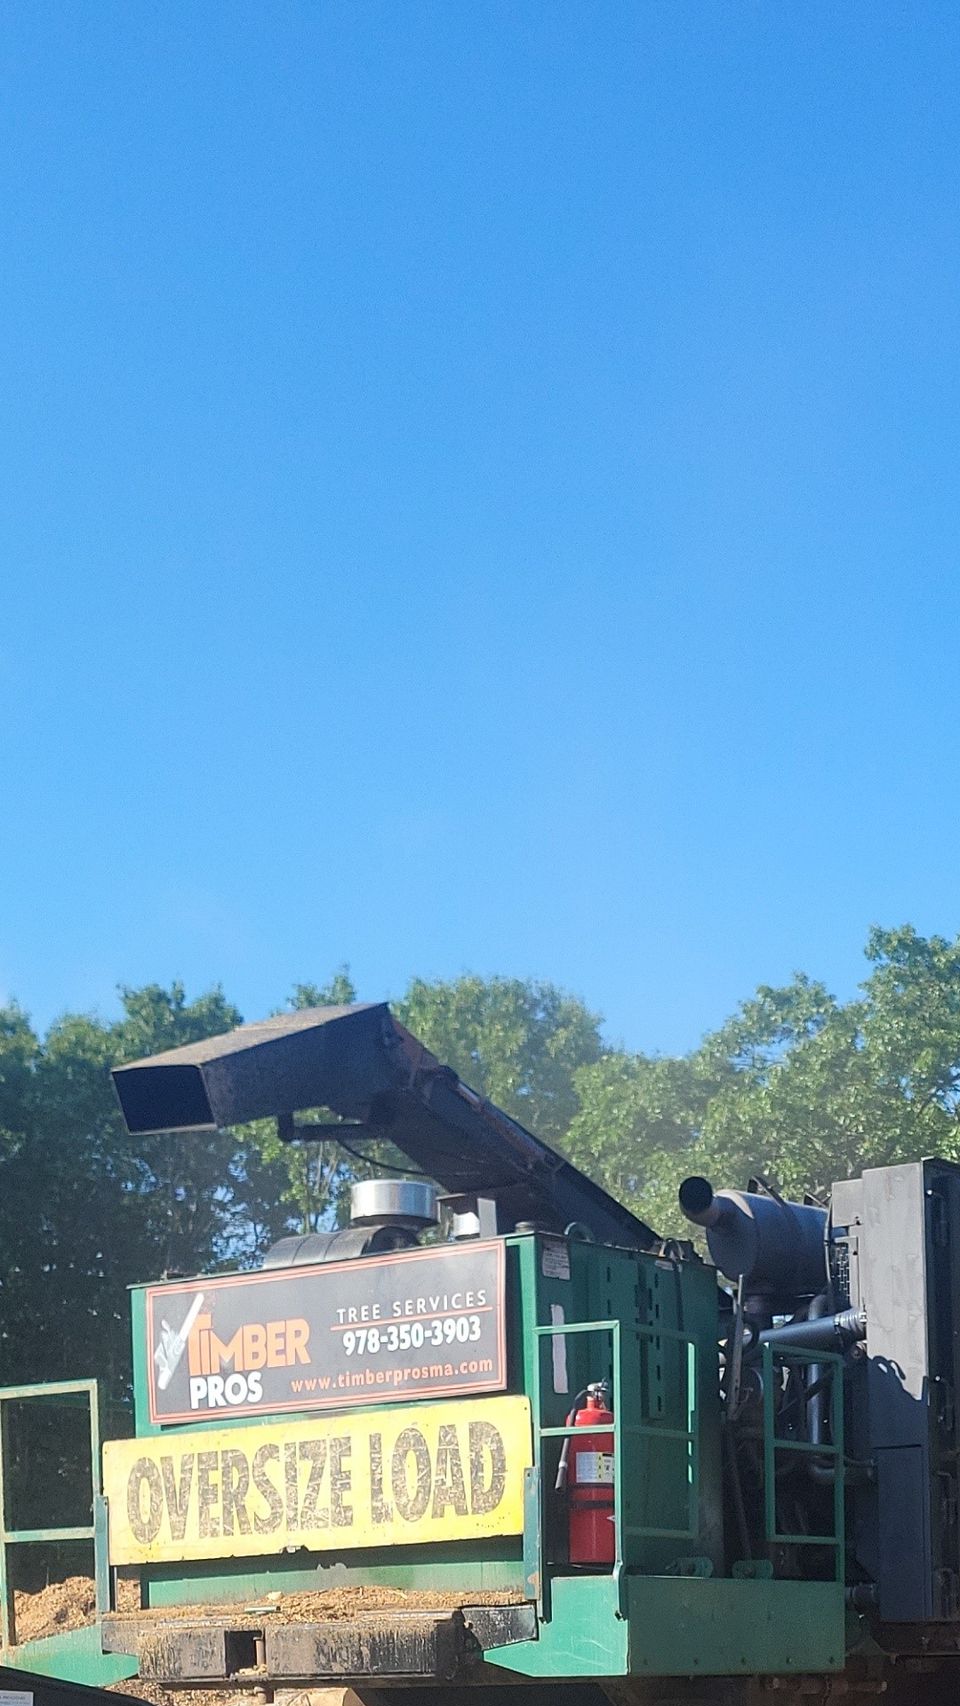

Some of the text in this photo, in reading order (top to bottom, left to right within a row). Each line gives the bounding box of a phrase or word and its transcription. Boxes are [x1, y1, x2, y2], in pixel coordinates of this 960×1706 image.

[336, 1290, 487, 1324] TREE SERVICES
[342, 1315, 481, 1356] 978-350-3903
[189, 1371, 263, 1409] PROS
[291, 1358, 493, 1393] www.timberprosma.com
[126, 1421, 507, 1544] OVERSIZE LOAD
